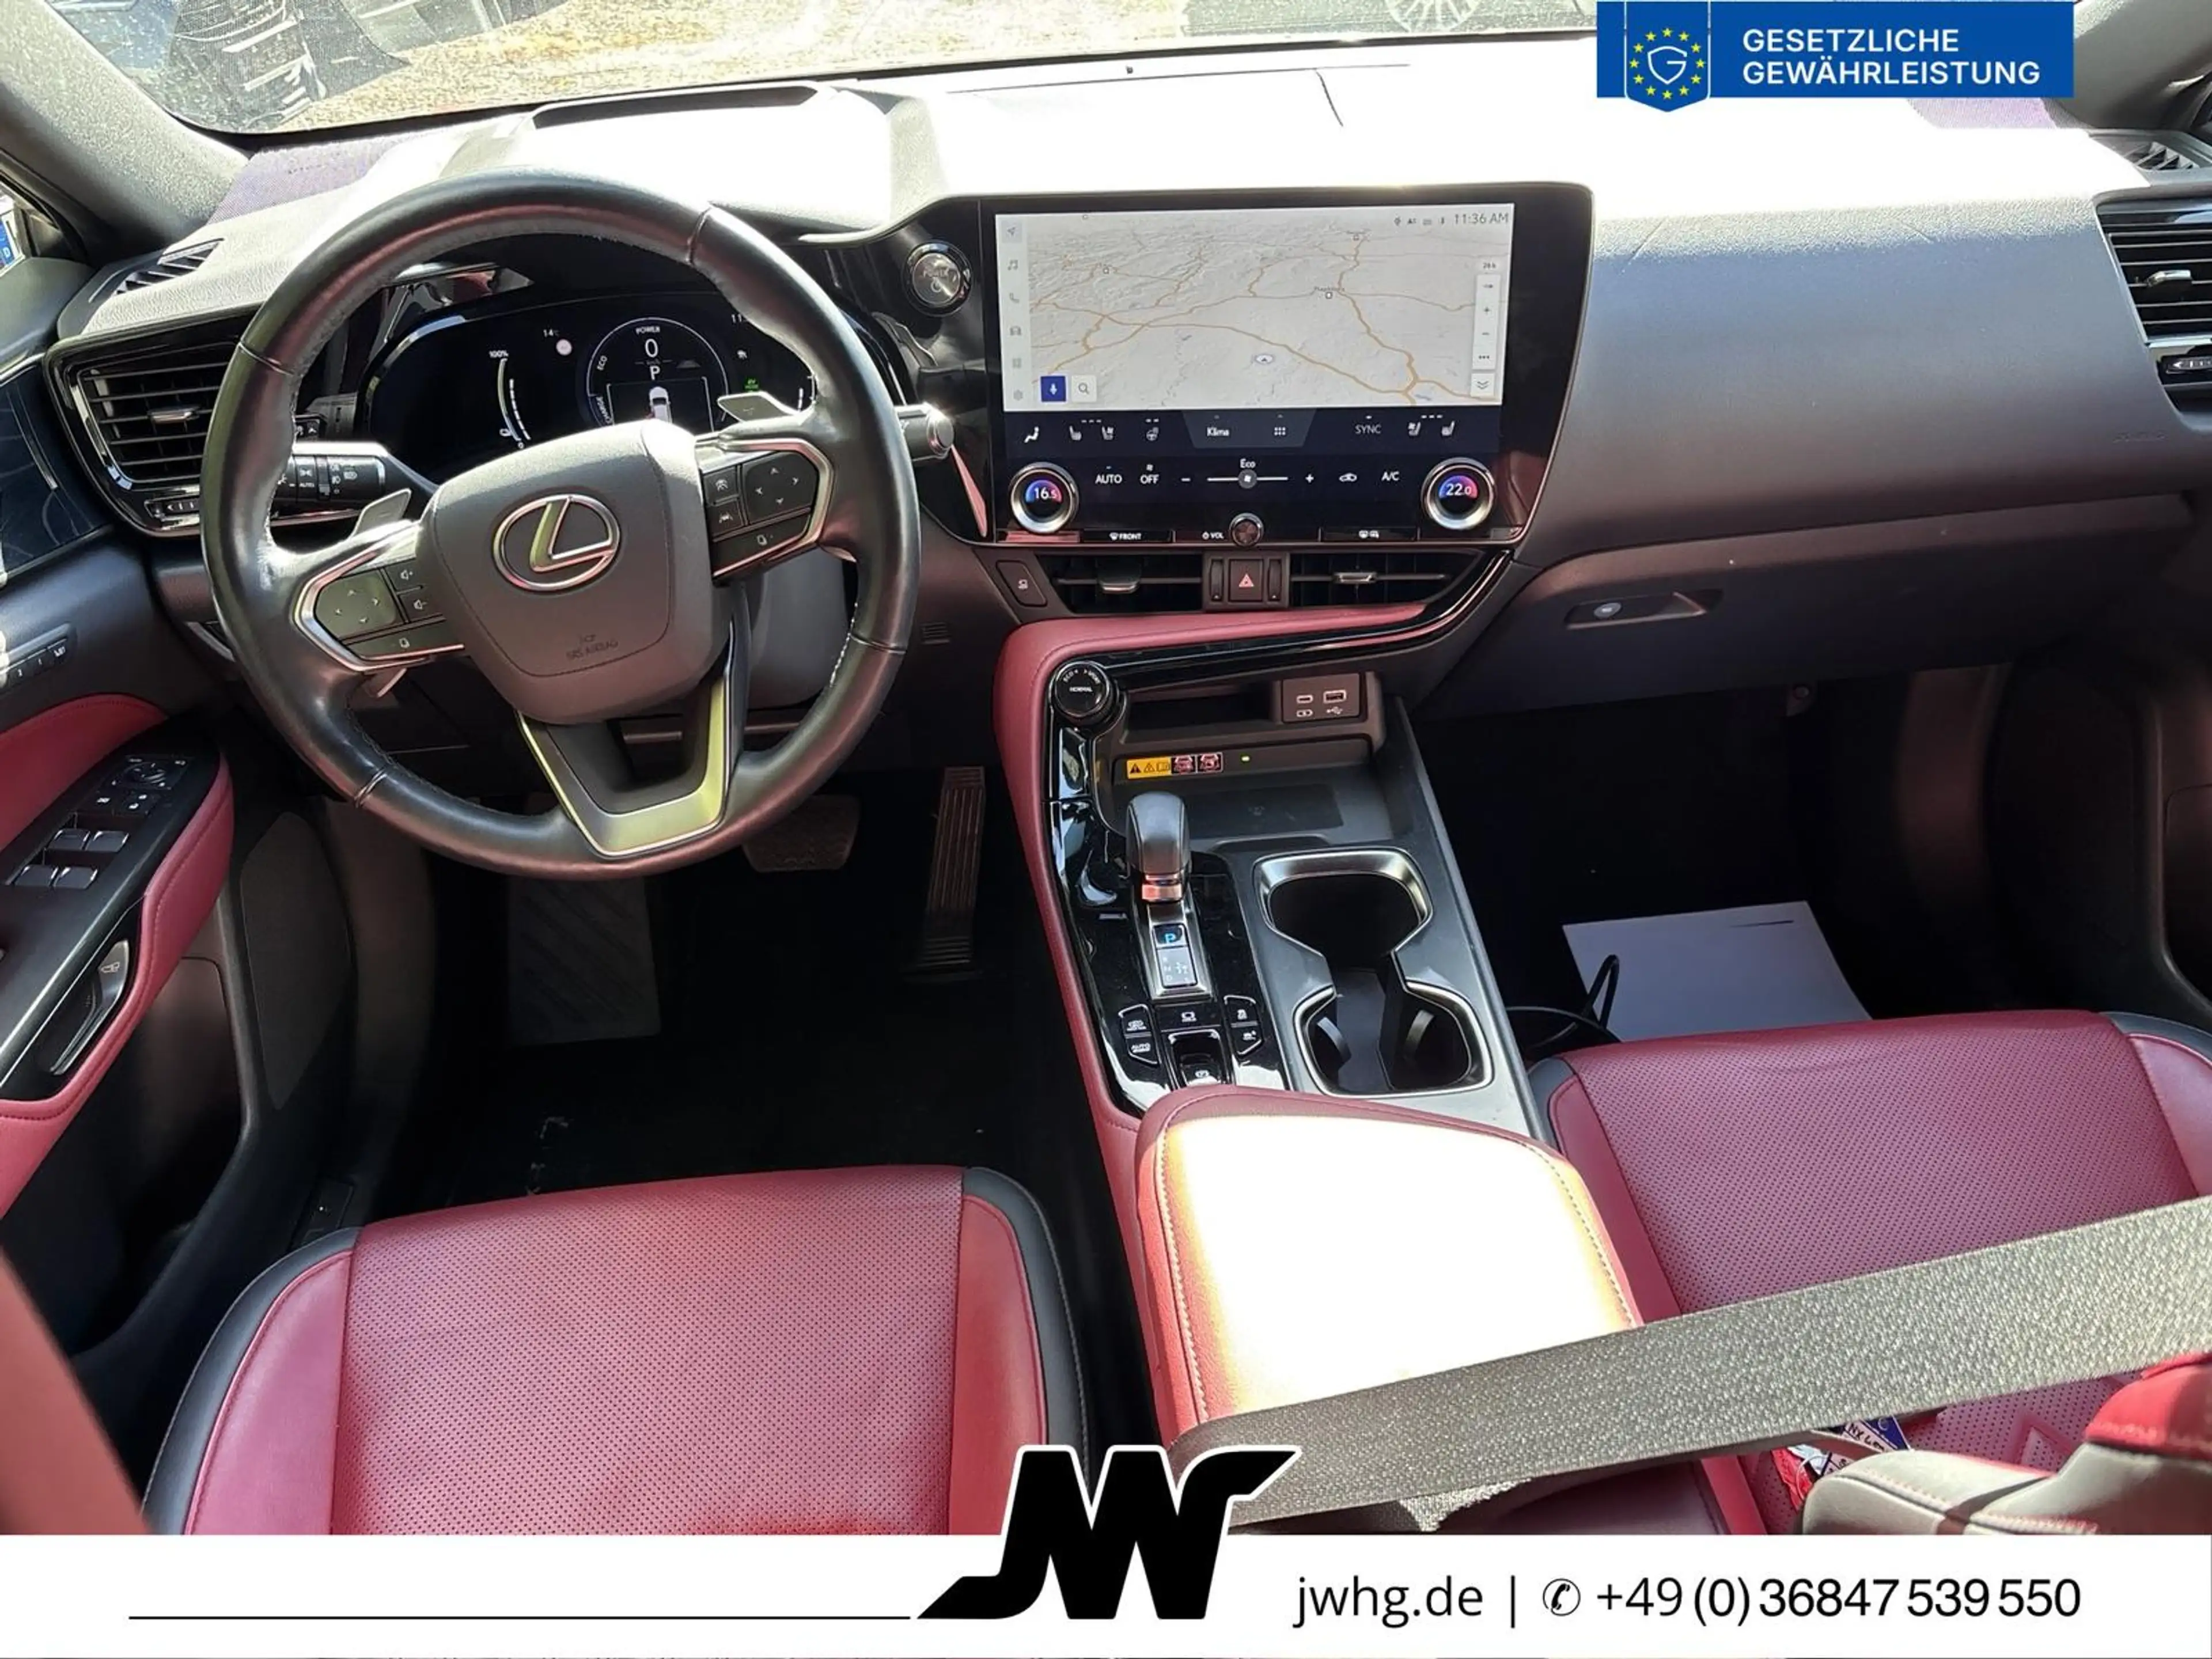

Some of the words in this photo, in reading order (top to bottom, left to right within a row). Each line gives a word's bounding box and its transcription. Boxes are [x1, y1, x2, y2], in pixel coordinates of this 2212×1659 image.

[1455, 213, 1487, 225] 11:36
[1488, 212, 1509, 224] AM
[635, 325, 661, 335] POWER
[645, 338, 658, 358] 0
[489, 350, 509, 358] 100%
[597, 355, 608, 370] ECO
[649, 365, 661, 381] P
[1206, 426, 1230, 437] Klima
[1355, 423, 1382, 435] SYNC
[1239, 458, 1257, 469] Eco
[1095, 474, 1123, 485] AUTO
[1140, 474, 1159, 485] OFF
[1381, 471, 1400, 482] A/C
[1164, 933, 1177, 944] P
